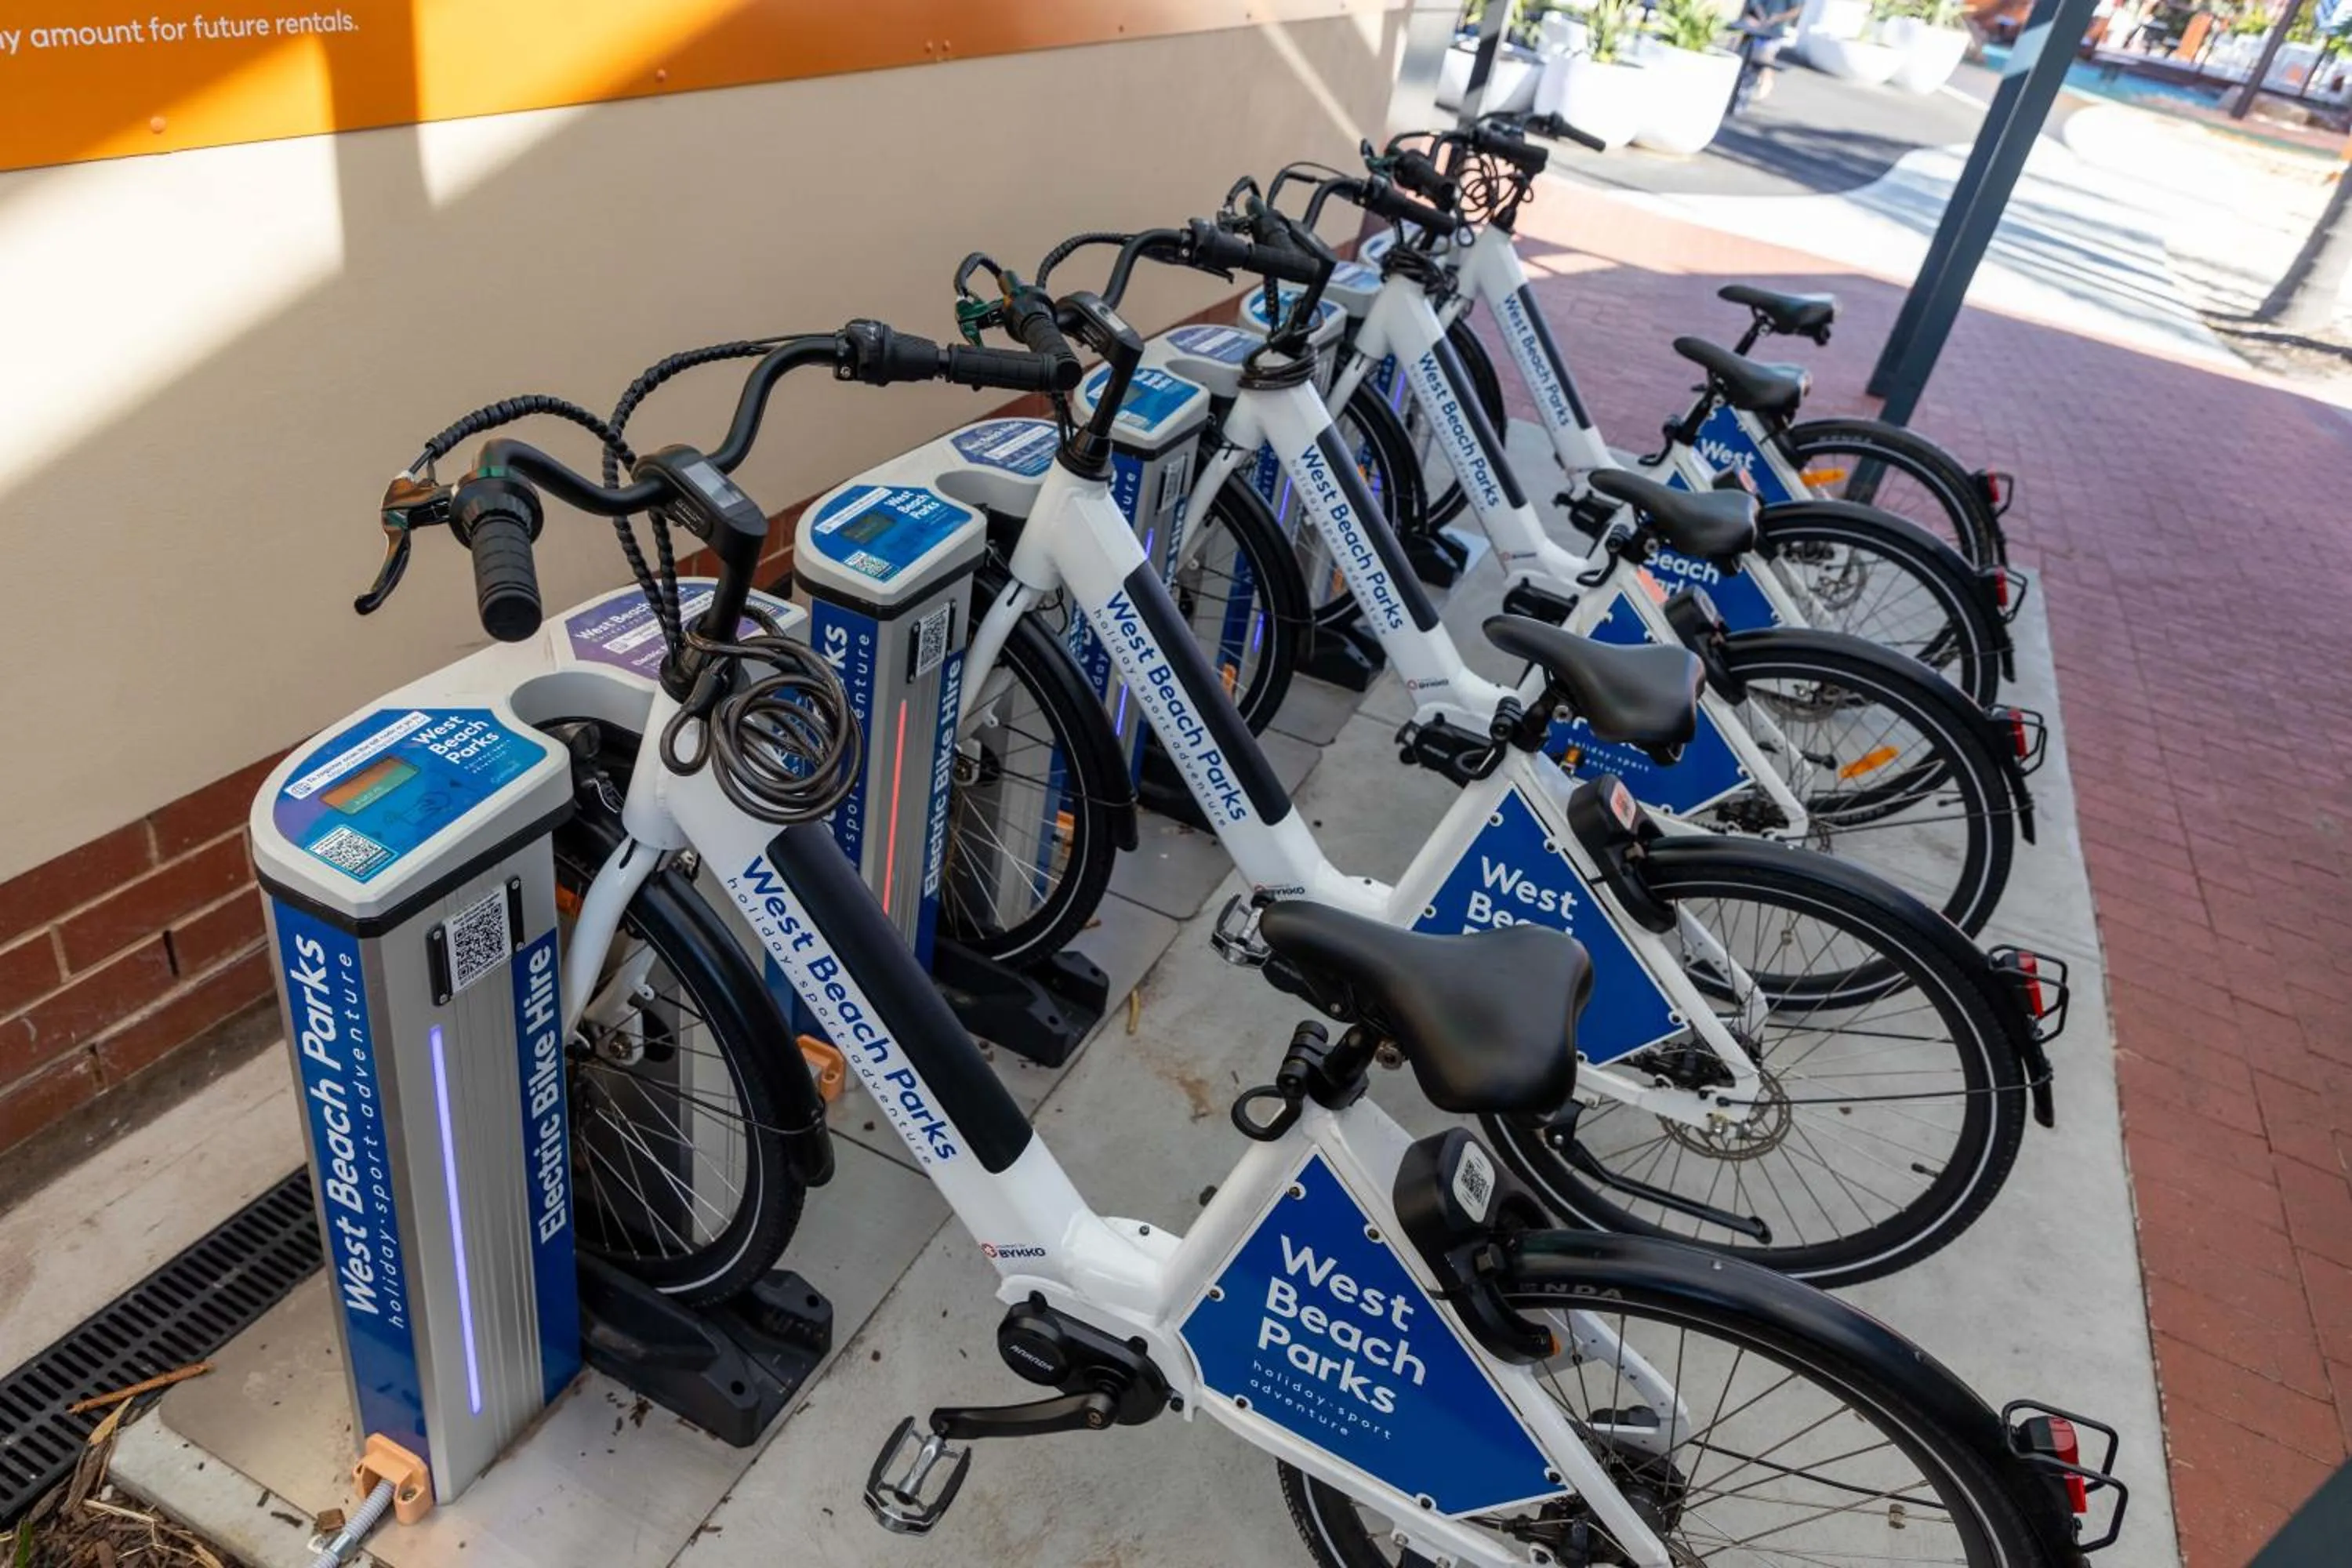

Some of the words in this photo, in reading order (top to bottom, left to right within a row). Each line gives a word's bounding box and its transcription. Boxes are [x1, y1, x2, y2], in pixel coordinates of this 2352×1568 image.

[30, 20, 145, 48] amount
[148, 16, 187, 42] for
[193, 14, 270, 38] future
[275, 9, 359, 35] rentals.
[1504, 293, 1528, 336] West
[1521, 336, 1551, 383] Beach
[1545, 383, 1570, 426] Parks
[1418, 352, 1448, 401] West
[1442, 401, 1476, 457] Beach
[1470, 457, 1501, 507] Parks
[1700, 437, 1755, 470] West
[1301, 445, 1338, 503] West
[1330, 503, 1373, 570] Beach
[1367, 571, 1403, 630] Parks
[412, 716, 465, 744] West
[428, 720, 490, 755] Beach
[845, 782, 860, 842] spor
[855, 633, 870, 720] enture
[941, 659, 960, 720] Hire
[1094, 608, 1136, 675] holiday
[1138, 685, 1171, 731] sport
[1172, 741, 1227, 827] adventure
[1106, 590, 1155, 664] West
[1147, 665, 1204, 747] Beach
[1197, 750, 1247, 821] Parks
[445, 732, 499, 764] Parks
[934, 727, 953, 796] Bike
[1585, 758, 1624, 776] enture
[923, 794, 946, 898] Electric
[1481, 855, 1578, 920] West
[289, 934, 342, 1071] Parks
[339, 953, 374, 1117] adventure
[524, 945, 555, 1035] Hire
[727, 877, 793, 966] holiday
[798, 980, 847, 1040] sport
[851, 1054, 931, 1164] adventure
[742, 855, 815, 953] West
[808, 954, 890, 1064] Beach
[884, 1067, 957, 1160] Parks
[528, 1029, 560, 1120] Bike
[310, 1078, 364, 1214] Beach
[363, 1136, 390, 1214] sport
[534, 1113, 567, 1244] Electric
[336, 1216, 379, 1315] West
[379, 1229, 405, 1329] holiday
[1280, 1233, 1414, 1332] West
[1257, 1316, 1397, 1414] Parks
[1265, 1276, 1427, 1387] Beach
[1250, 1377, 1349, 1436] adventure
[1253, 1360, 1326, 1406] holiday
[1338, 1406, 1392, 1440] sport
